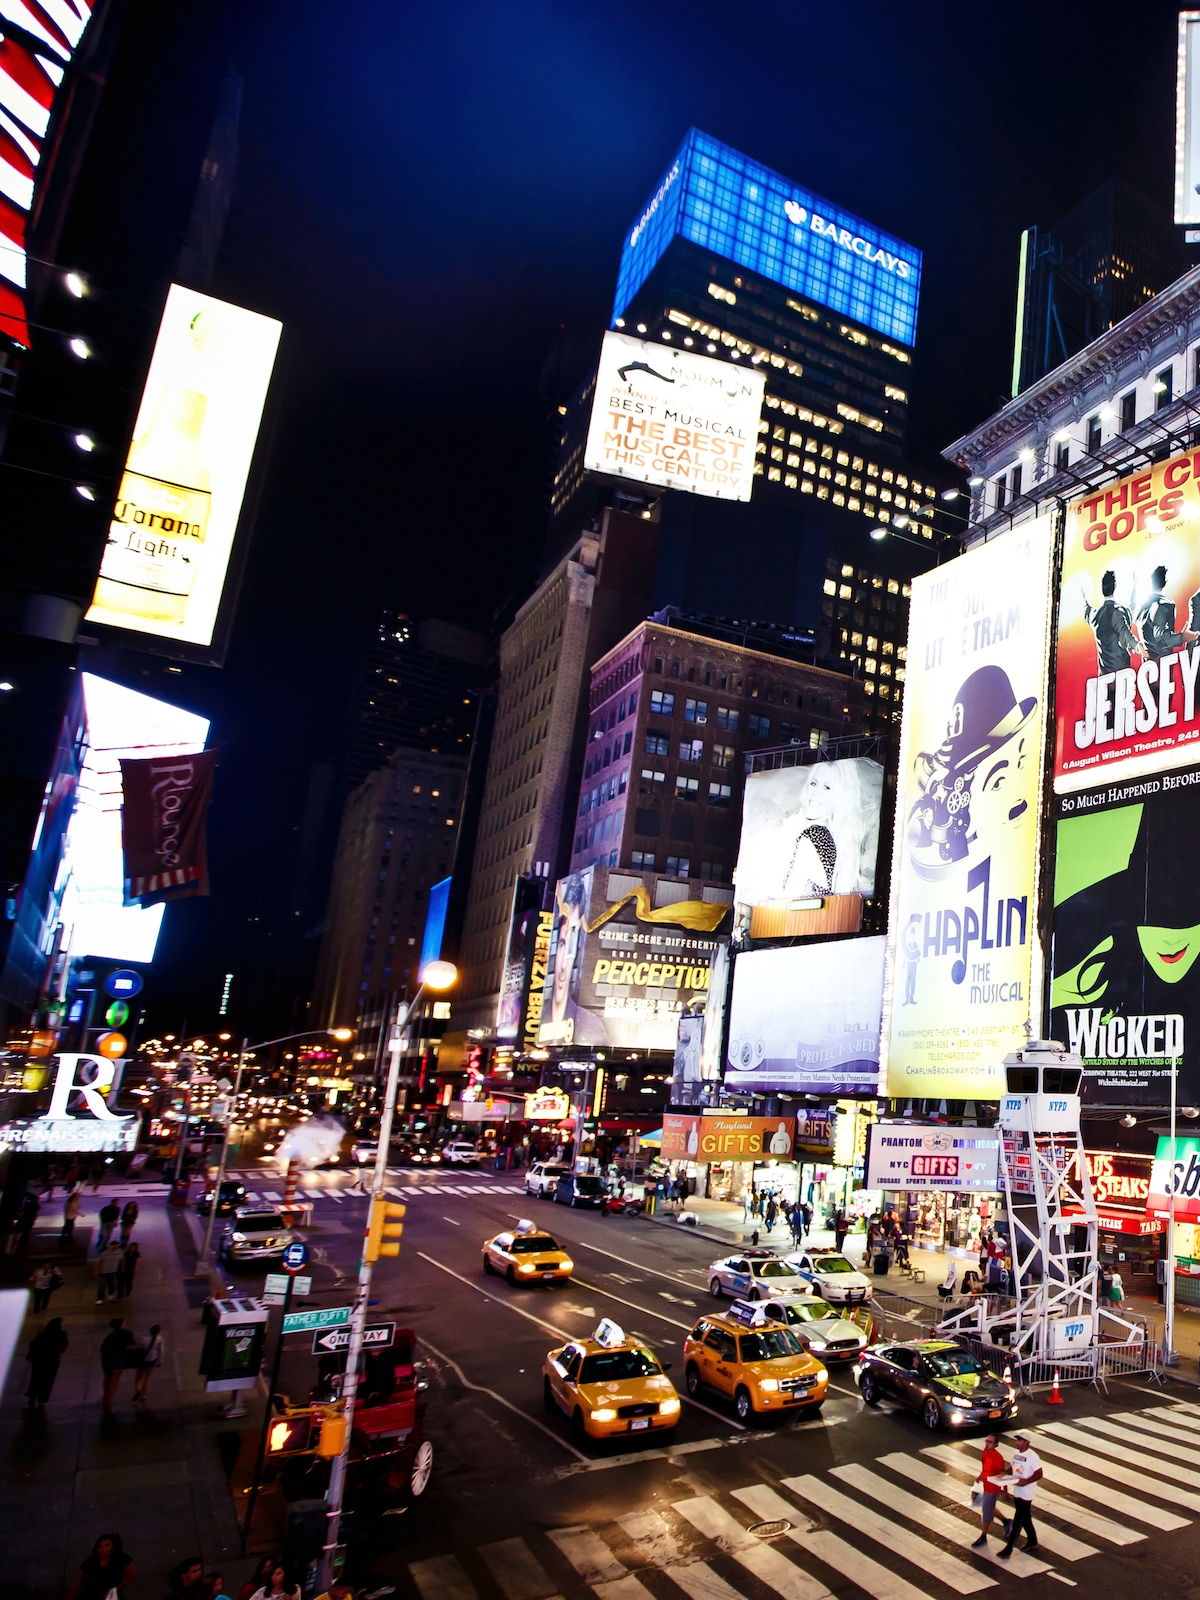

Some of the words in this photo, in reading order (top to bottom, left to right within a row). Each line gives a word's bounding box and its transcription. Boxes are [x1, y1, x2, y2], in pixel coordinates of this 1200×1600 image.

[810, 213, 910, 279] BARCLAYS
[611, 386, 658, 403] WINNER
[609, 396, 657, 416] BEST
[664, 409, 746, 440] MUSICAL
[603, 431, 706, 467] MUSICAL
[712, 458, 743, 474] OF
[673, 427, 745, 459] BEST
[602, 446, 645, 467] THIS
[114, 499, 201, 533] Corona
[1083, 492, 1195, 551] GOES
[1165, 520, 1184, 532] New
[126, 528, 181, 557] Light
[930, 578, 949, 606] THE
[1068, 754, 1100, 769] August
[1101, 745, 1131, 760] Wilson
[1133, 737, 1175, 752] Theatre,
[1177, 730, 1200, 740] 245
[901, 856, 1029, 985] CHAPLIN
[598, 930, 629, 942] CRIME
[632, 933, 662, 946] SCENE
[530, 911, 554, 990] FUERZA
[611, 950, 638, 959] ERIC
[972, 963, 990, 982] THE
[970, 982, 1024, 1005] MUSICAL
[902, 1028, 934, 1038] BARRYMORE
[935, 1028, 960, 1037] THEATRE
[980, 1026, 998, 1036] WEST
[41, 1052, 134, 1121] R
[1005, 1100, 1022, 1111] NYPD
[1048, 1101, 1068, 1112] NYPD
[713, 1120, 753, 1132] Playland
[803, 1120, 833, 1139] GIFTS
[701, 1134, 761, 1154] GIFTS
[881, 1137, 922, 1148] PHANTOM
[952, 1138, 999, 1149] BROADWAY
[889, 1161, 909, 1169] NYC
[913, 1156, 958, 1176] GIFTS
[1016, 1169, 1028, 1178] CAPS
[1097, 1176, 1149, 1202] STEAKS
[1098, 1216, 1123, 1230] STEAKS
[1140, 1219, 1162, 1233] TAD'S
[284, 1314, 318, 1327] FATHER
[320, 1310, 350, 1324] DUFFY
[1064, 1322, 1084, 1337] NYPD
